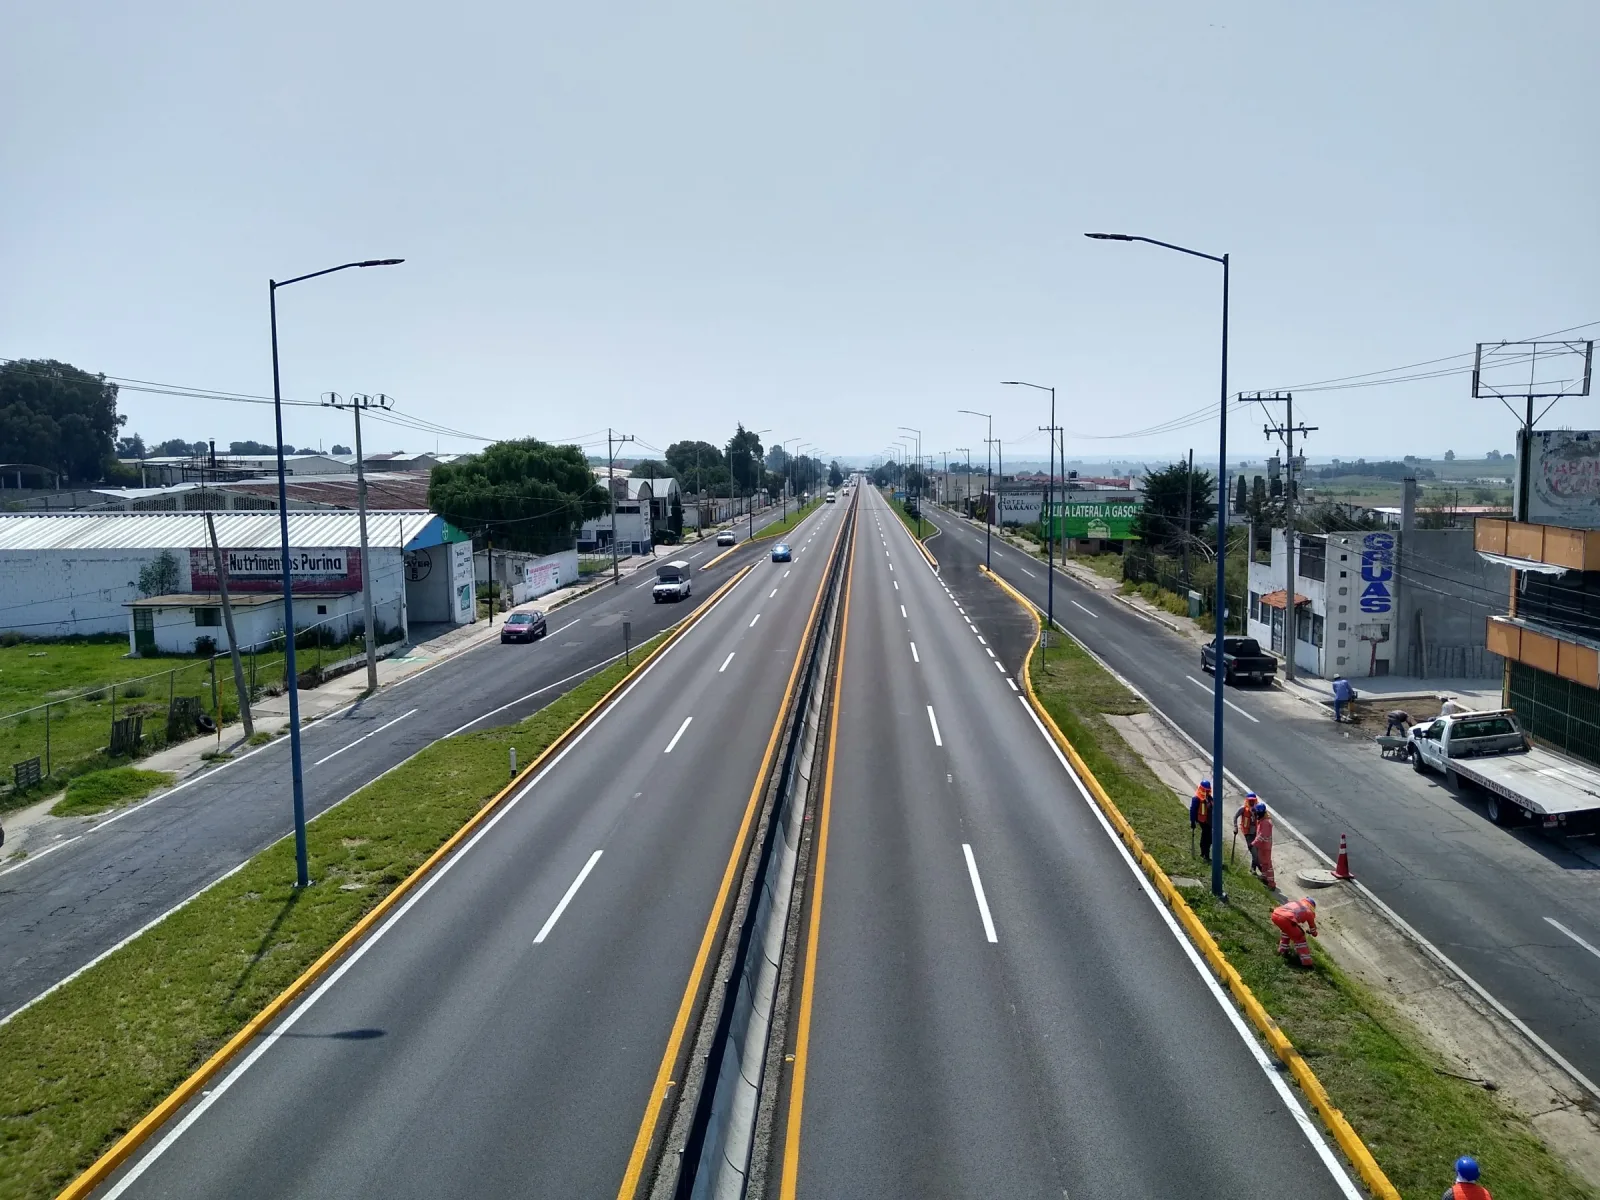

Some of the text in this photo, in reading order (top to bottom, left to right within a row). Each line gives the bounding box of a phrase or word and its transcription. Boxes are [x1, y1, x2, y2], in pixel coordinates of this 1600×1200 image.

[1072, 505, 1103, 517] LATERAL
[1105, 505, 1110, 517] A
[230, 553, 342, 571] Nutrimenos Purina
[1360, 533, 1394, 613] GRUAS
